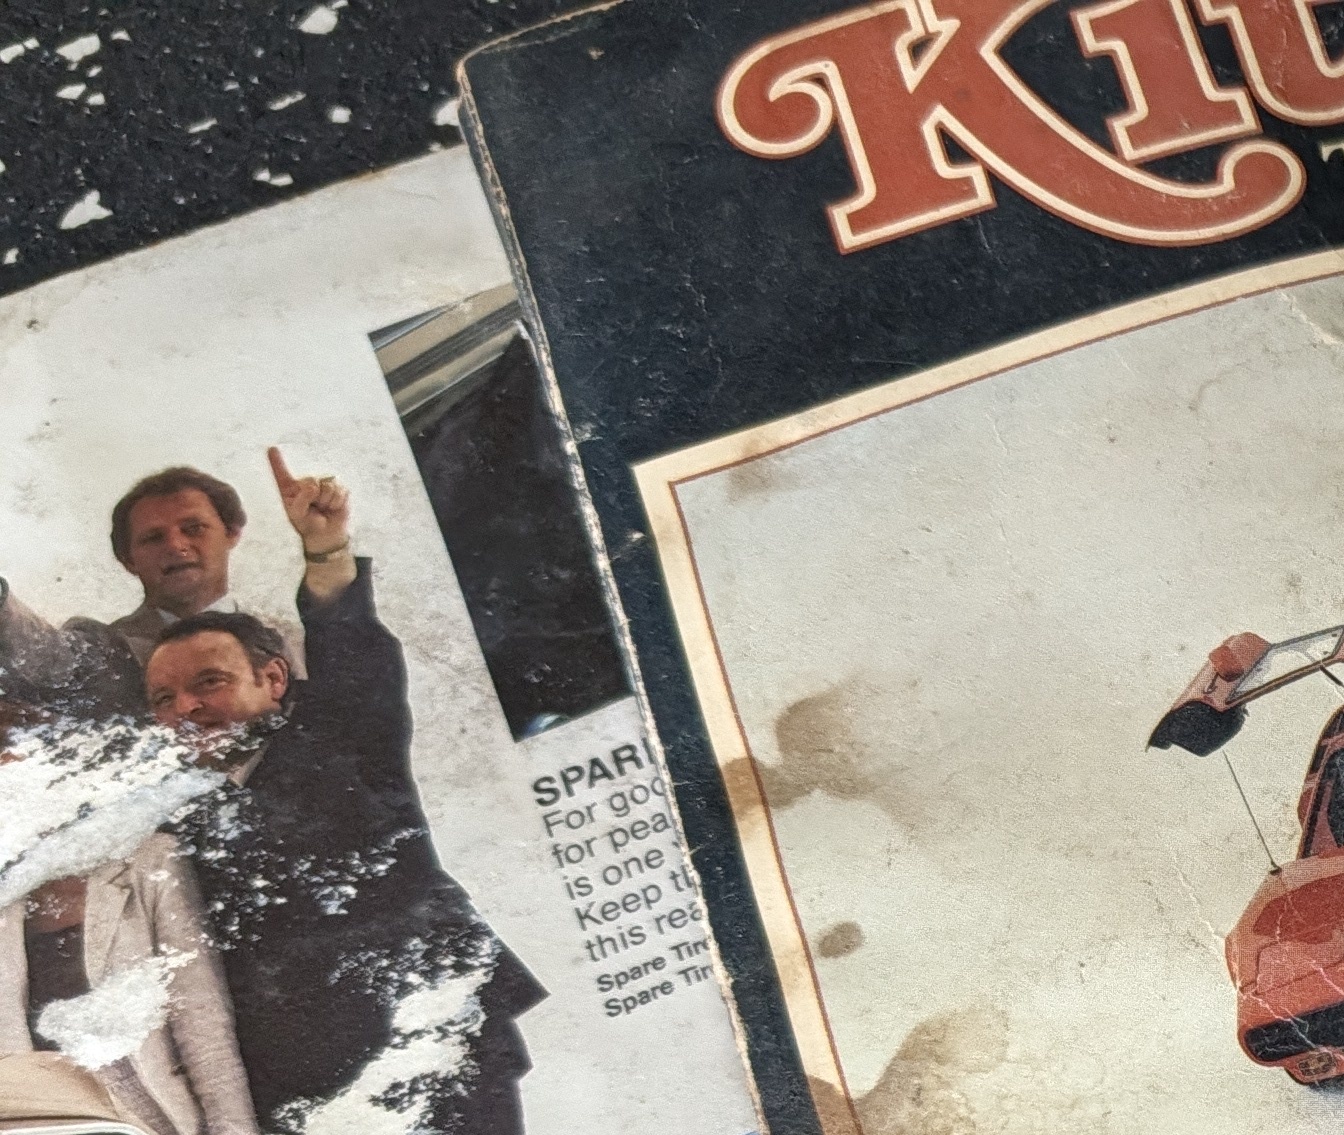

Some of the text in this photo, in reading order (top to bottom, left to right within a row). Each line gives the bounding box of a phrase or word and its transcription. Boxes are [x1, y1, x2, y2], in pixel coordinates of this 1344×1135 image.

[542, 802, 598, 838] For
[552, 811, 672, 868] for pea
[562, 848, 665, 900] is one
[575, 884, 663, 931] Keep
[585, 925, 647, 963] this
[596, 956, 667, 993] Spare
[604, 979, 675, 1018] Spare
